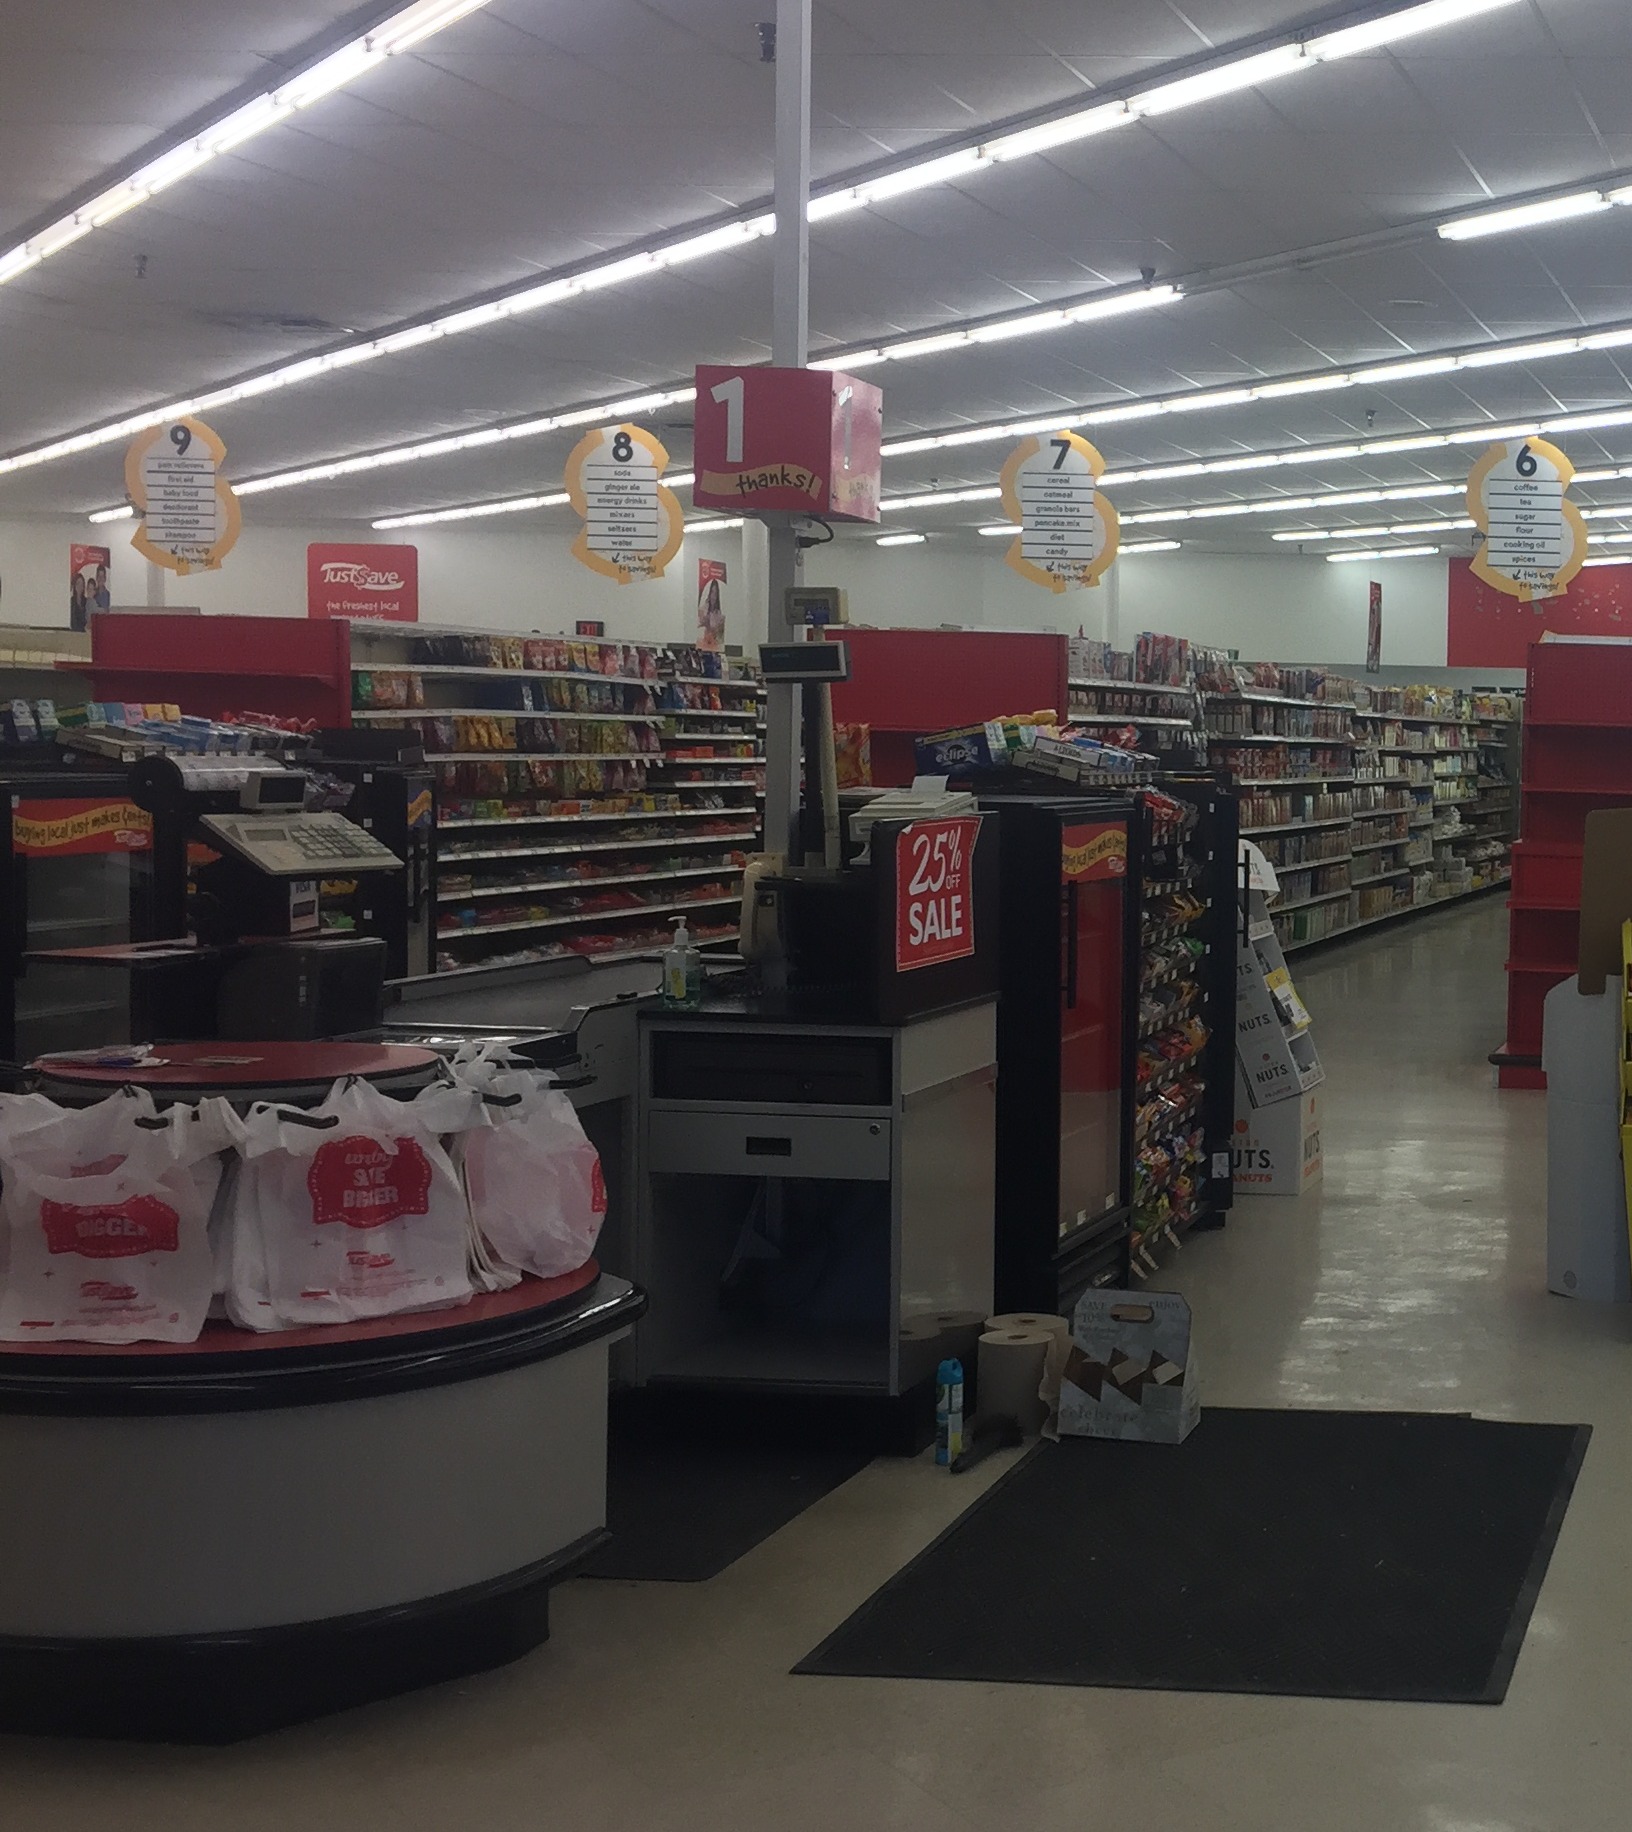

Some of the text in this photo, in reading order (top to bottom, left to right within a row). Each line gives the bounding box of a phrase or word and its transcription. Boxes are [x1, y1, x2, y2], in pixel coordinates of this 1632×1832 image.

[710, 376, 745, 462] 1
[170, 425, 192, 455] 9
[612, 431, 634, 463] 8
[1050, 439, 1072, 470] 7
[1516, 444, 1538, 477] 6
[736, 465, 818, 500] thanks!
[604, 484, 628, 492] ginger
[163, 489, 199, 498] baby food
[1043, 491, 1073, 499] oatmeal
[625, 497, 647, 505] drinks
[1035, 505, 1080, 514] granola bars
[1515, 513, 1536, 521] sugar
[1034, 519, 1081, 528] pancake mix
[608, 525, 637, 533] seltzers
[1515, 526, 1534, 534] flour
[1050, 533, 1065, 541] diet
[1503, 541, 1546, 550] cooking oil
[1045, 547, 1068, 556] candy
[1512, 555, 1536, 564] spices
[1523, 570, 1538, 579] this
[15, 822, 46, 846] buying
[47, 820, 68, 839] local
[91, 810, 120, 829] makes
[907, 825, 962, 896] 25%
[946, 873, 961, 890] OFF
[909, 895, 963, 946] SALE
